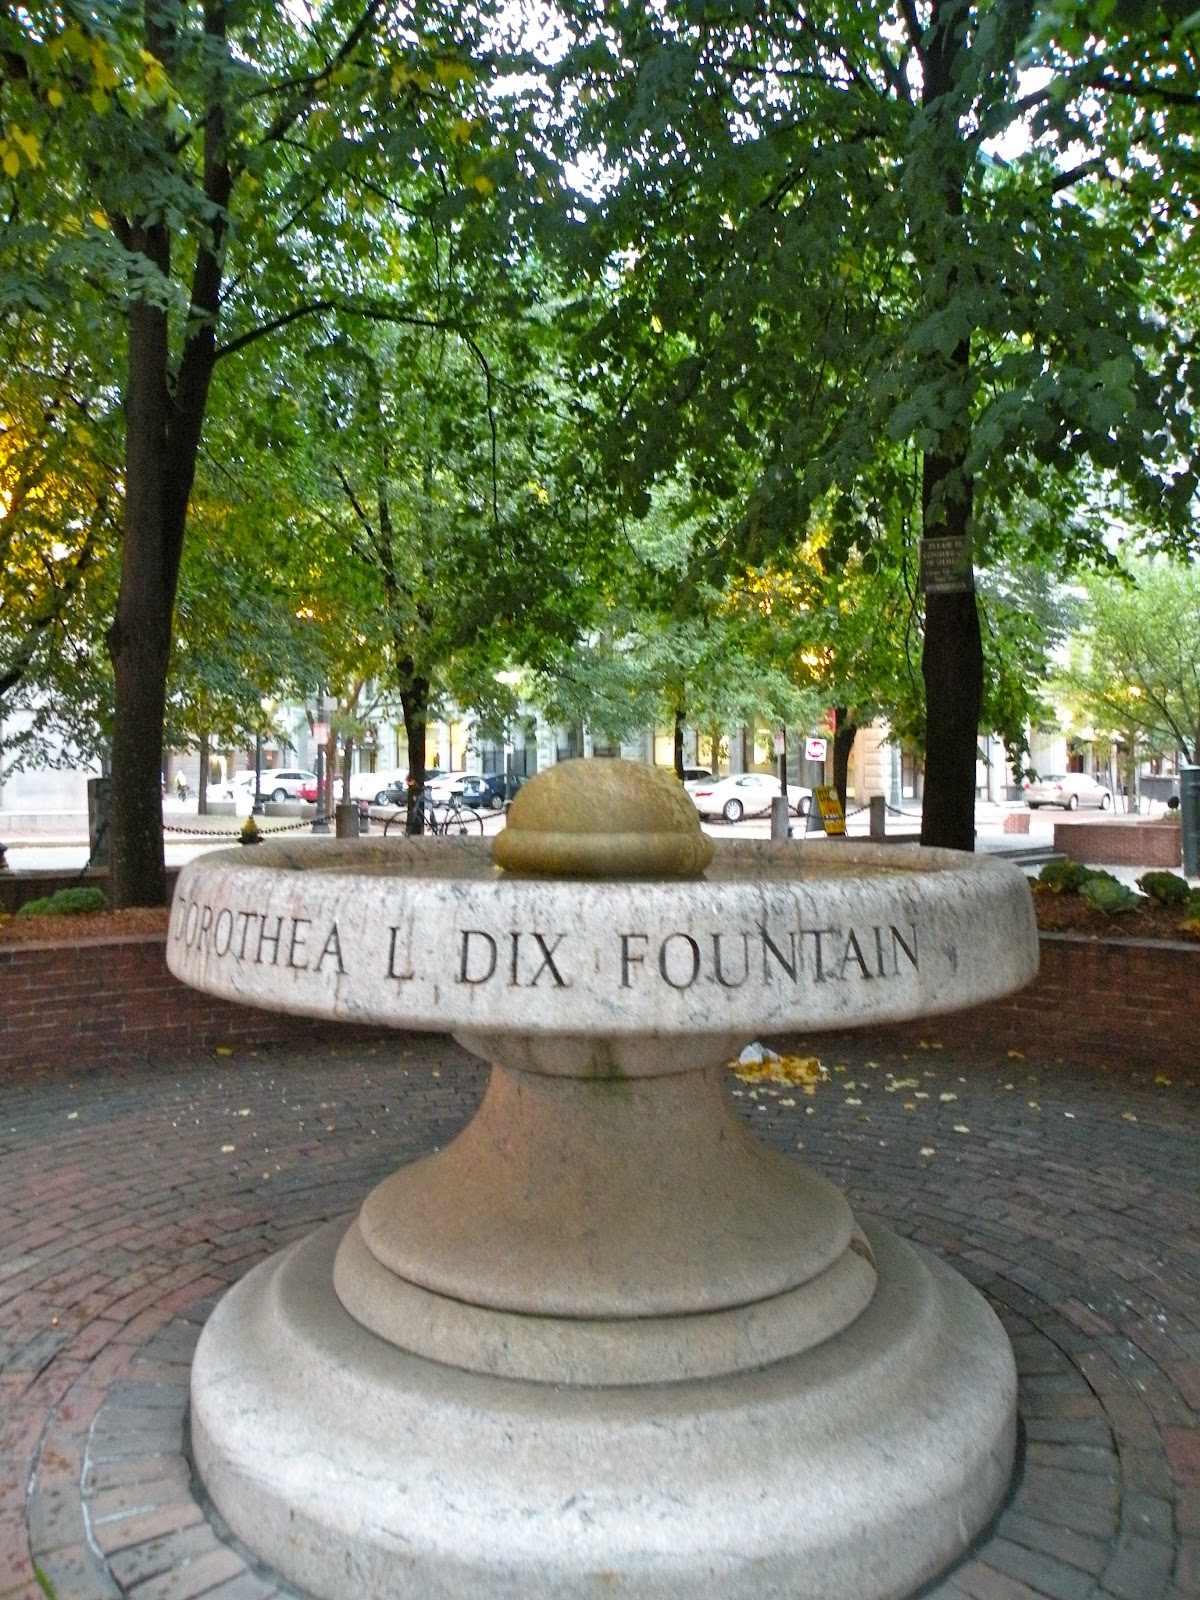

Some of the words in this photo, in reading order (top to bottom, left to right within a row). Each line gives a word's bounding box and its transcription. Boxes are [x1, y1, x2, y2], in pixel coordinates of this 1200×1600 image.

[174, 896, 345, 975] DOROTHEA
[454, 930, 571, 988] DIX
[618, 921, 920, 990] FOUNTAIN
